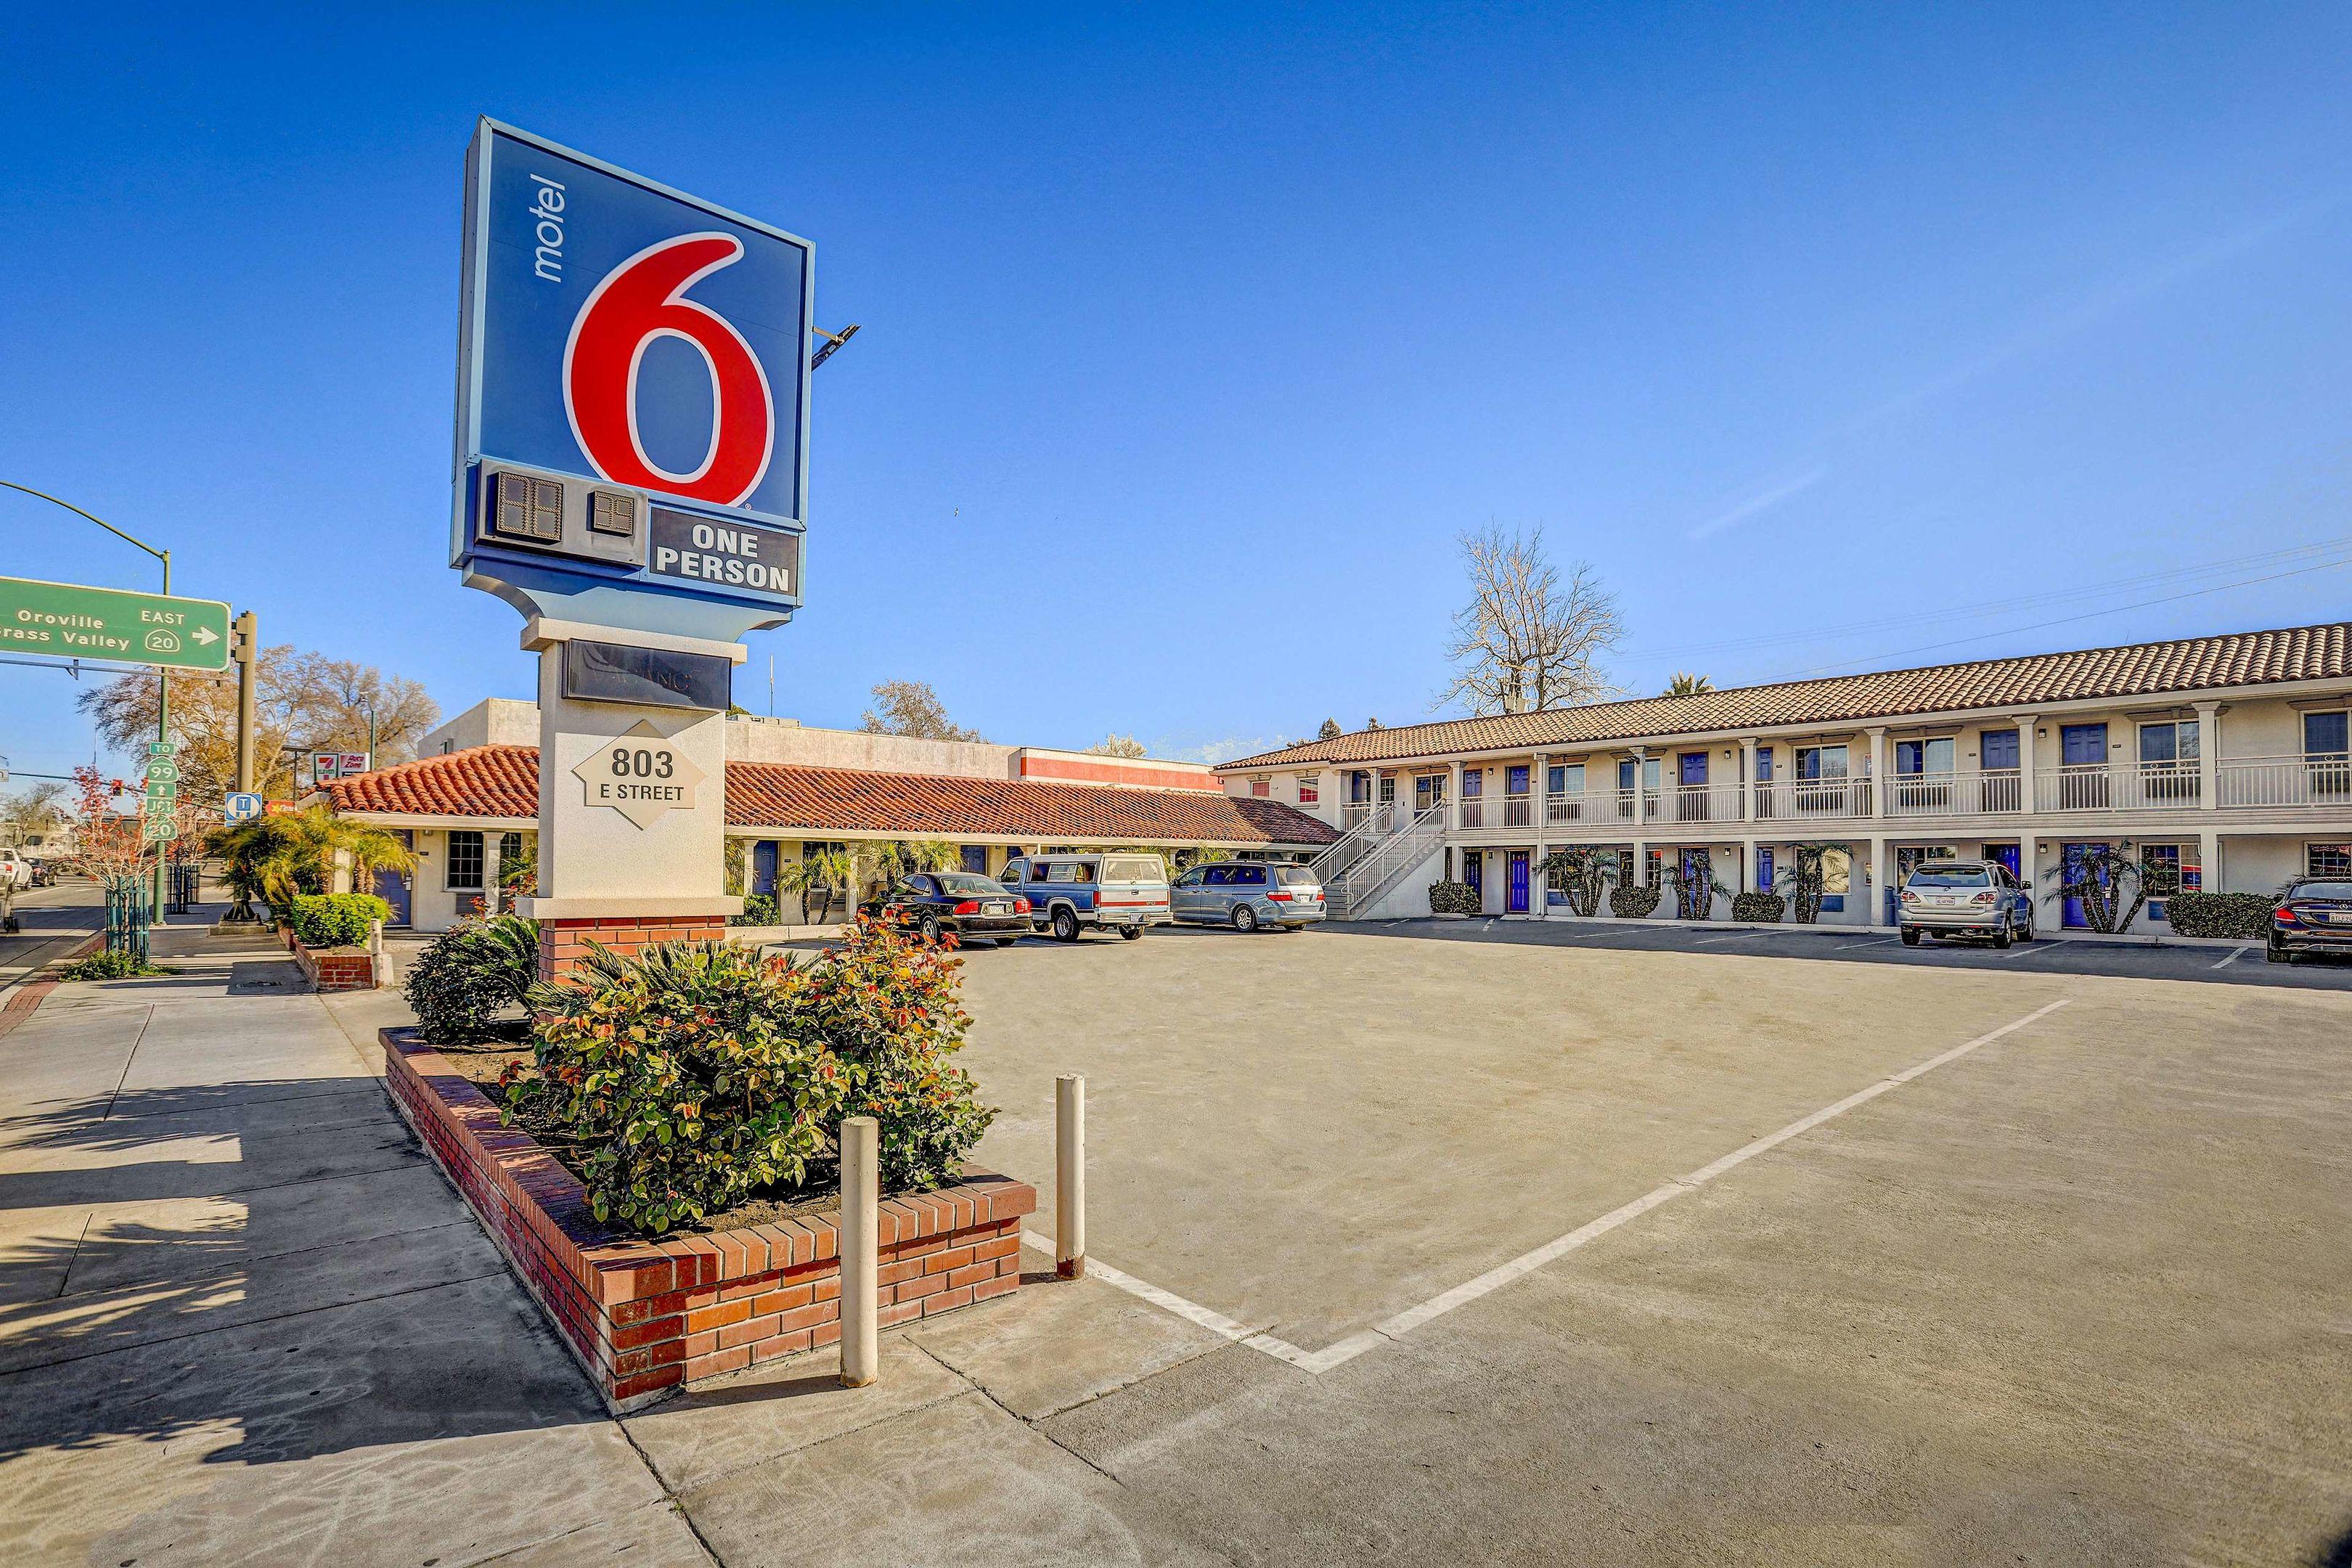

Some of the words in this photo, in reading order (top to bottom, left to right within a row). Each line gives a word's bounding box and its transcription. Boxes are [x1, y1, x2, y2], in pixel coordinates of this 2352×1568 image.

[528, 173, 565, 282] motel
[562, 231, 775, 509] 6
[692, 523, 759, 558] ONE
[656, 546, 789, 592] PERSON
[17, 609, 105, 629] Oroville
[141, 610, 185, 625] EAST
[0, 626, 51, 642] rass
[63, 631, 130, 651] Valley
[152, 636, 173, 649] 20
[151, 767, 173, 779] 99
[318, 757, 334, 780] 7
[612, 748, 674, 779] 803
[600, 783, 610, 798] E
[617, 784, 684, 801] STREET
[148, 801, 172, 812] JCT
